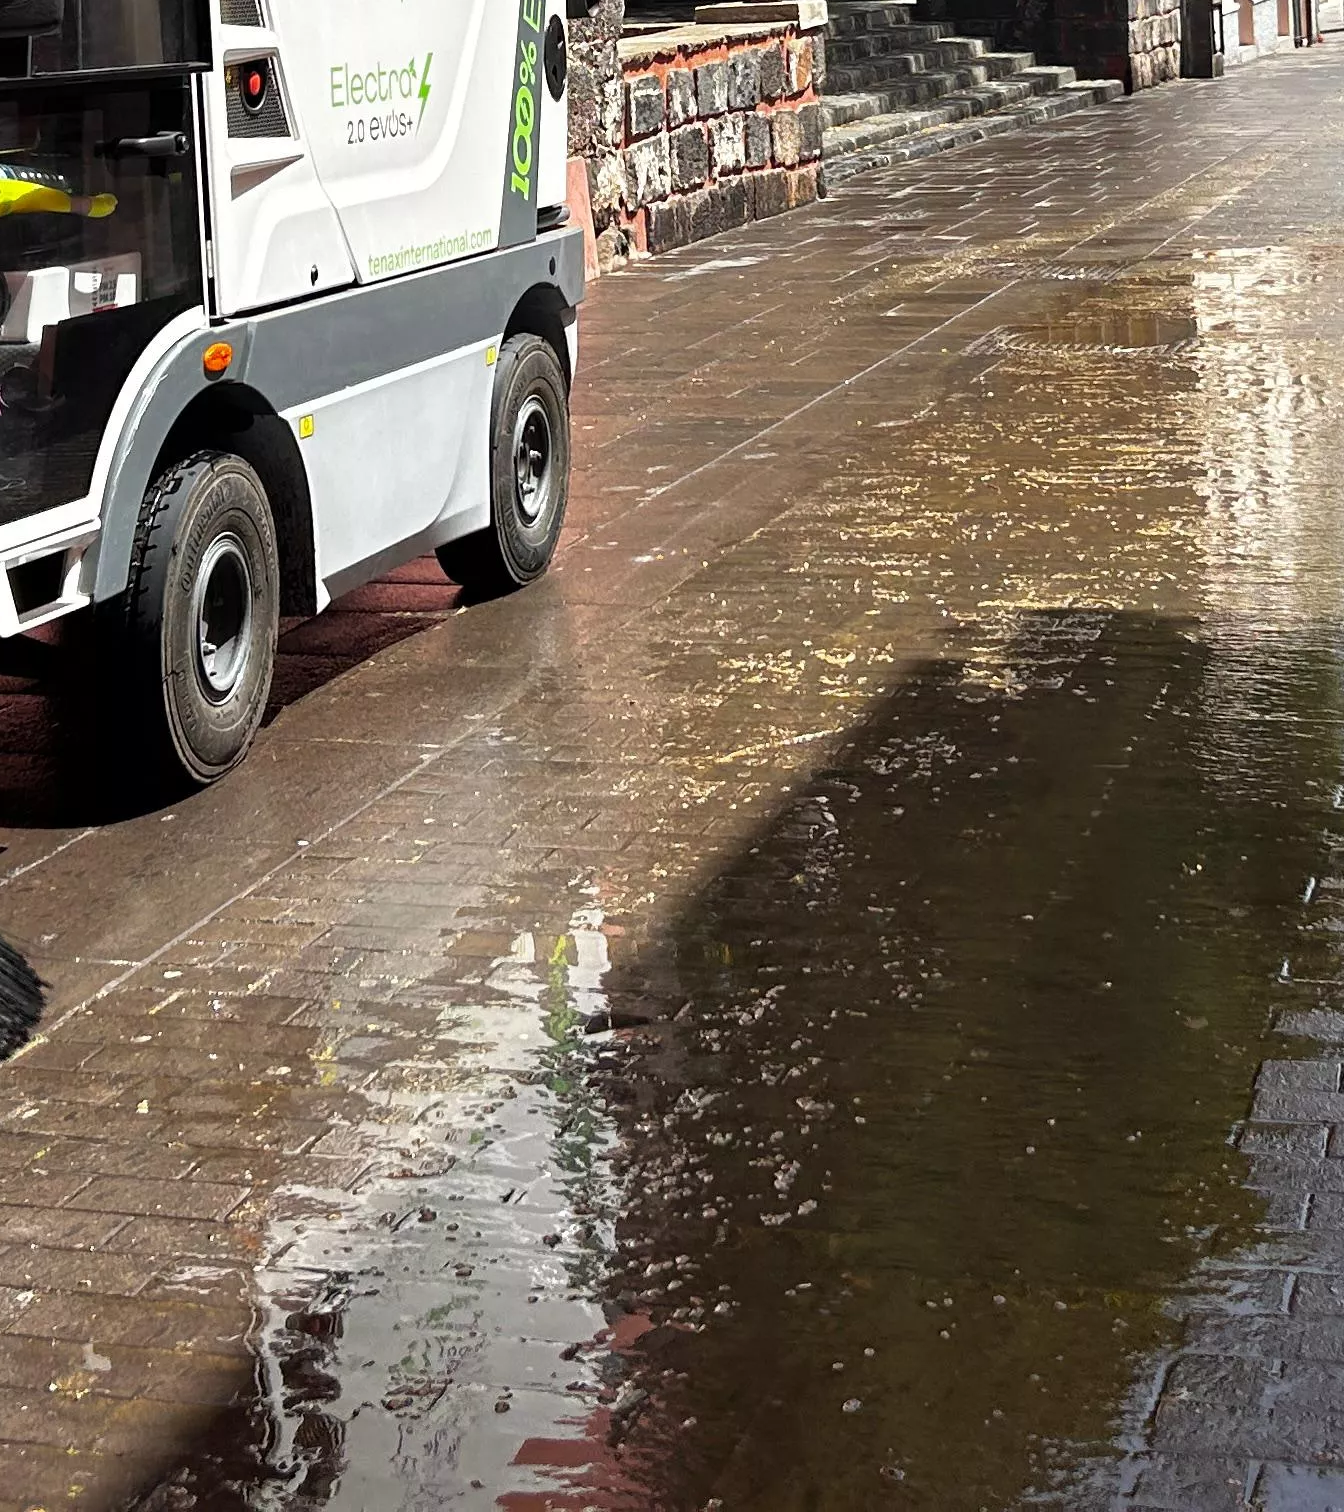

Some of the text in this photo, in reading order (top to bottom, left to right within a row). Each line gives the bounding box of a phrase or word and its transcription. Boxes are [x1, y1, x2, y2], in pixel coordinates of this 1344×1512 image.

[330, 60, 414, 108] Electra
[347, 119, 365, 145] 2.0
[510, 39, 538, 202] 100%
[367, 228, 493, 277] tenaxinternational.com
